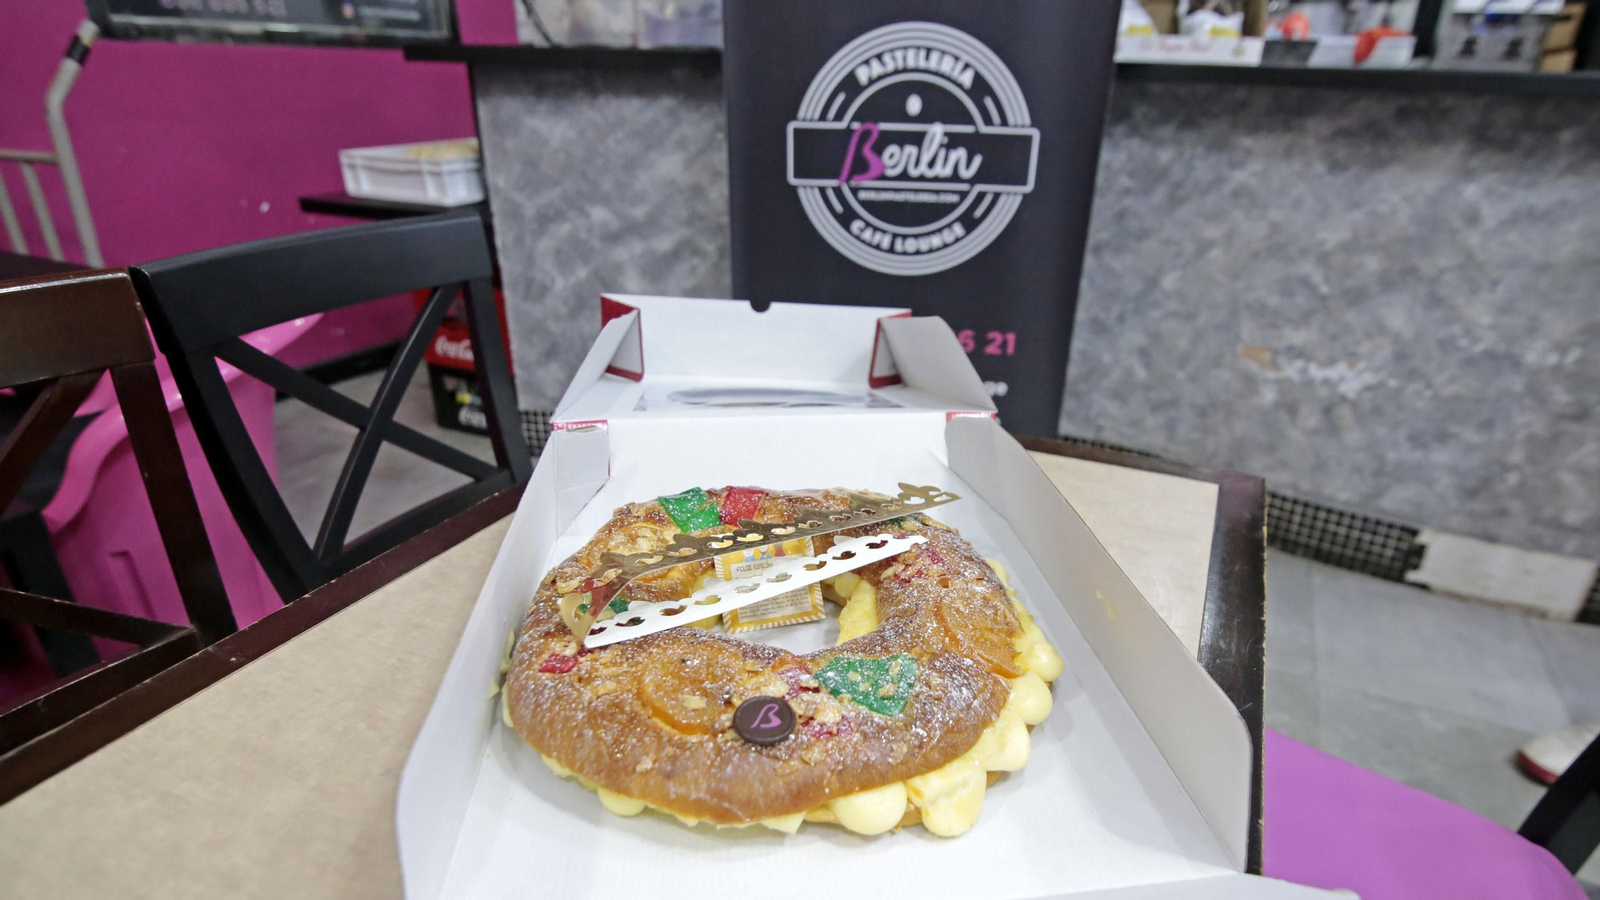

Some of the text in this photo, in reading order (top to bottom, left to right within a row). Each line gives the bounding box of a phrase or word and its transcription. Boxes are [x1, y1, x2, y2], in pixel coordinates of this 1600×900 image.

[839, 122, 983, 186] Berlin
[850, 219, 965, 253] CAFÉ LOUNGE
[984, 331, 1016, 355] 21
[736, 564, 753, 573] FELIZ
